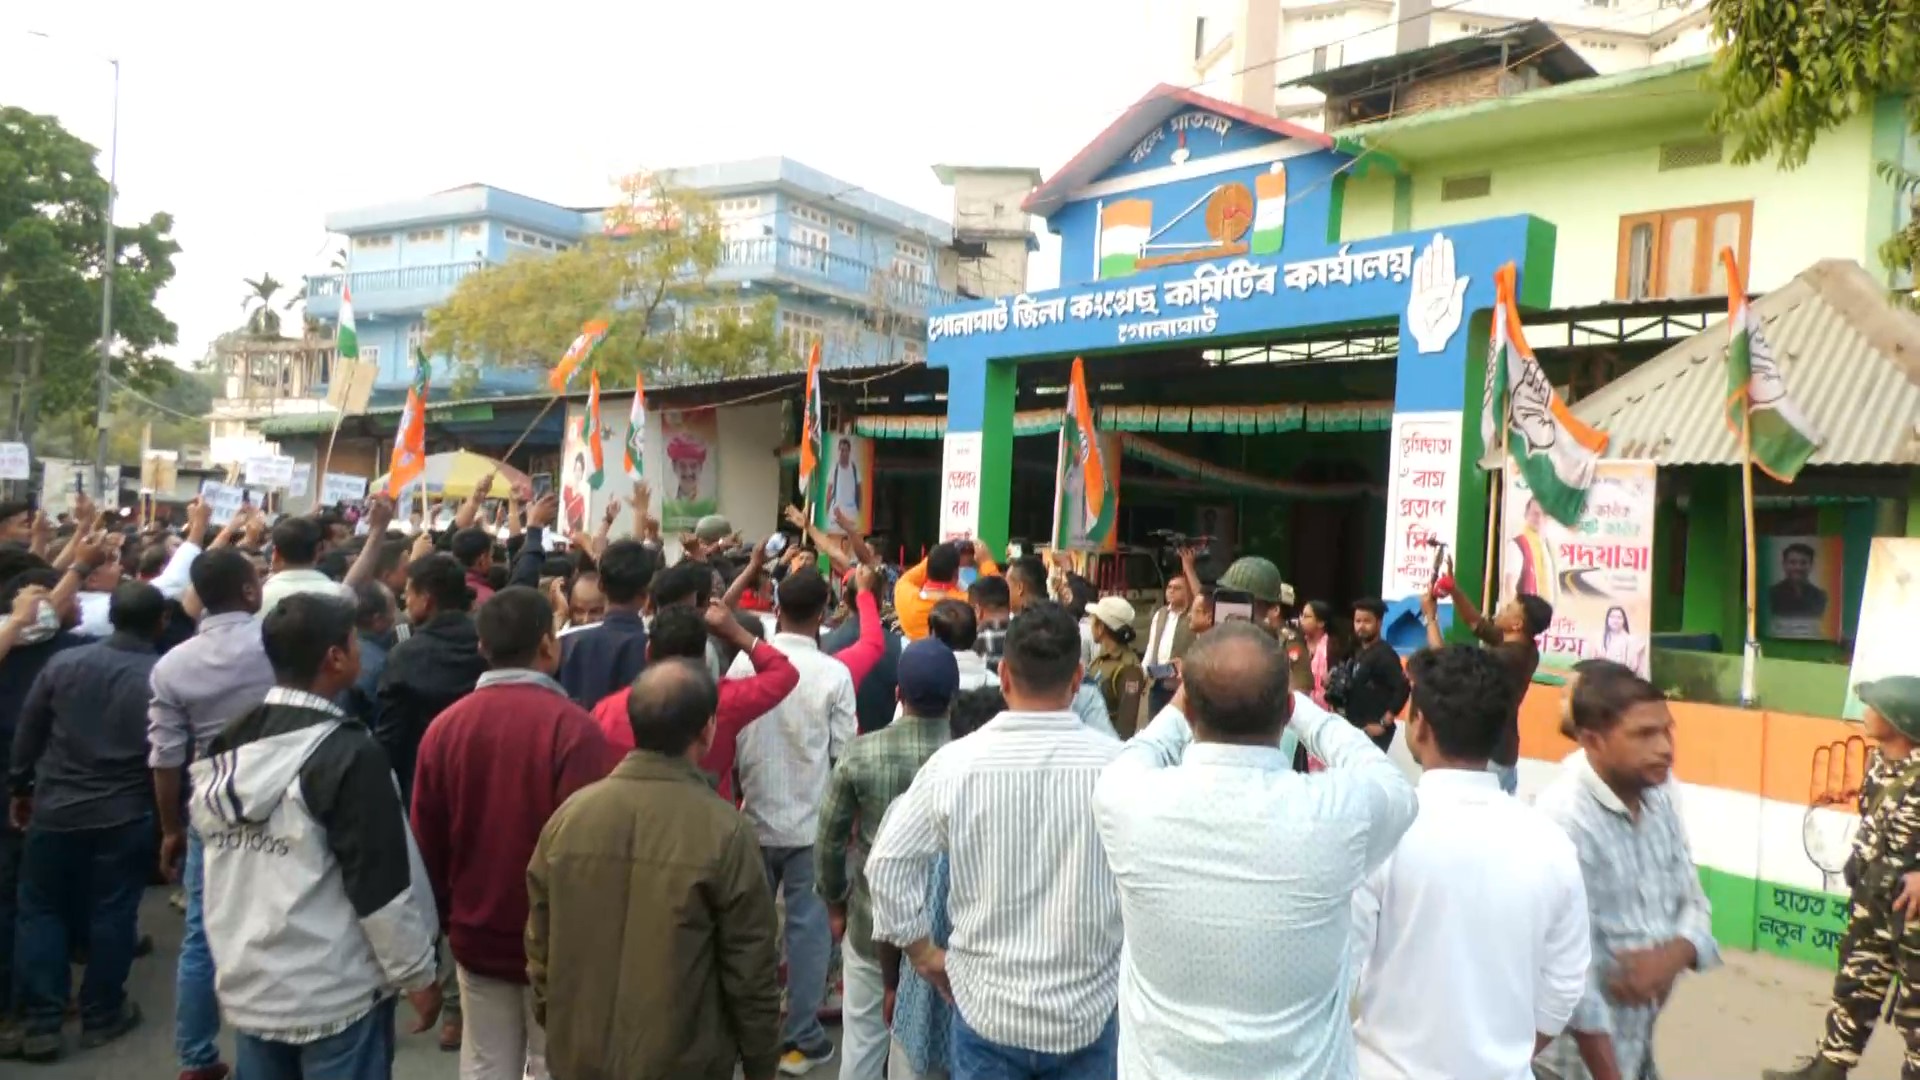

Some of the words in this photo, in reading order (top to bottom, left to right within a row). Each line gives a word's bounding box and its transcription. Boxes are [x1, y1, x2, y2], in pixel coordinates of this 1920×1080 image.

[928, 298, 1008, 342] গোলাঘাট
[1012, 293, 1067, 329] জিলা
[1116, 306, 1219, 342] গোলাঘাট
[1773, 887, 1826, 917] হাতত
[1758, 914, 1807, 947] নতুন
